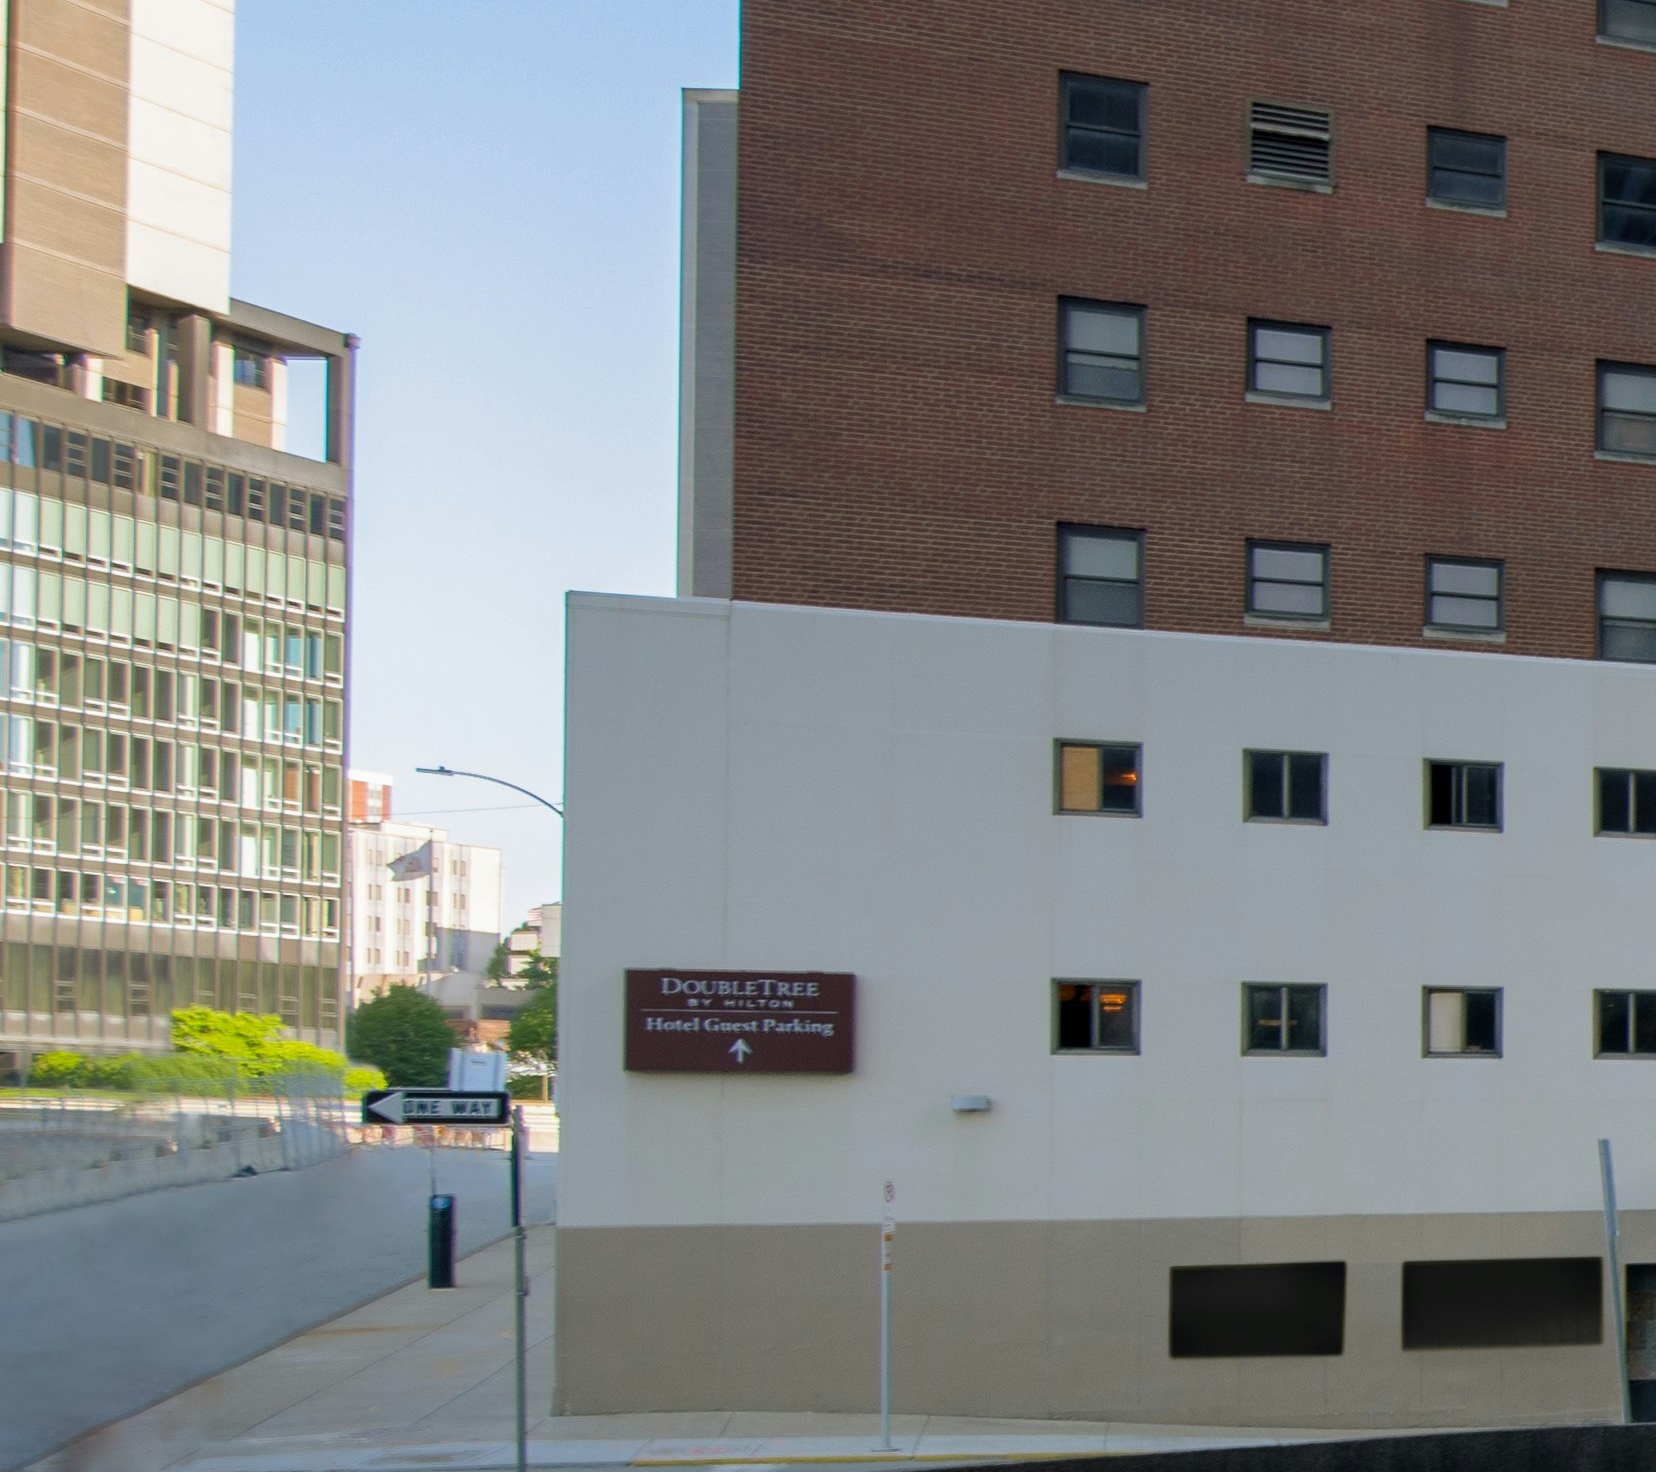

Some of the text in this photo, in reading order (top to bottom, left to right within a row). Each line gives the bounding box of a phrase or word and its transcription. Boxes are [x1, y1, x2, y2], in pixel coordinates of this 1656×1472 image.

[687, 998, 795, 1010] BY HILTON
[645, 1017, 835, 1037] Hotel Guest Parking
[452, 1101, 492, 1115] WAY
